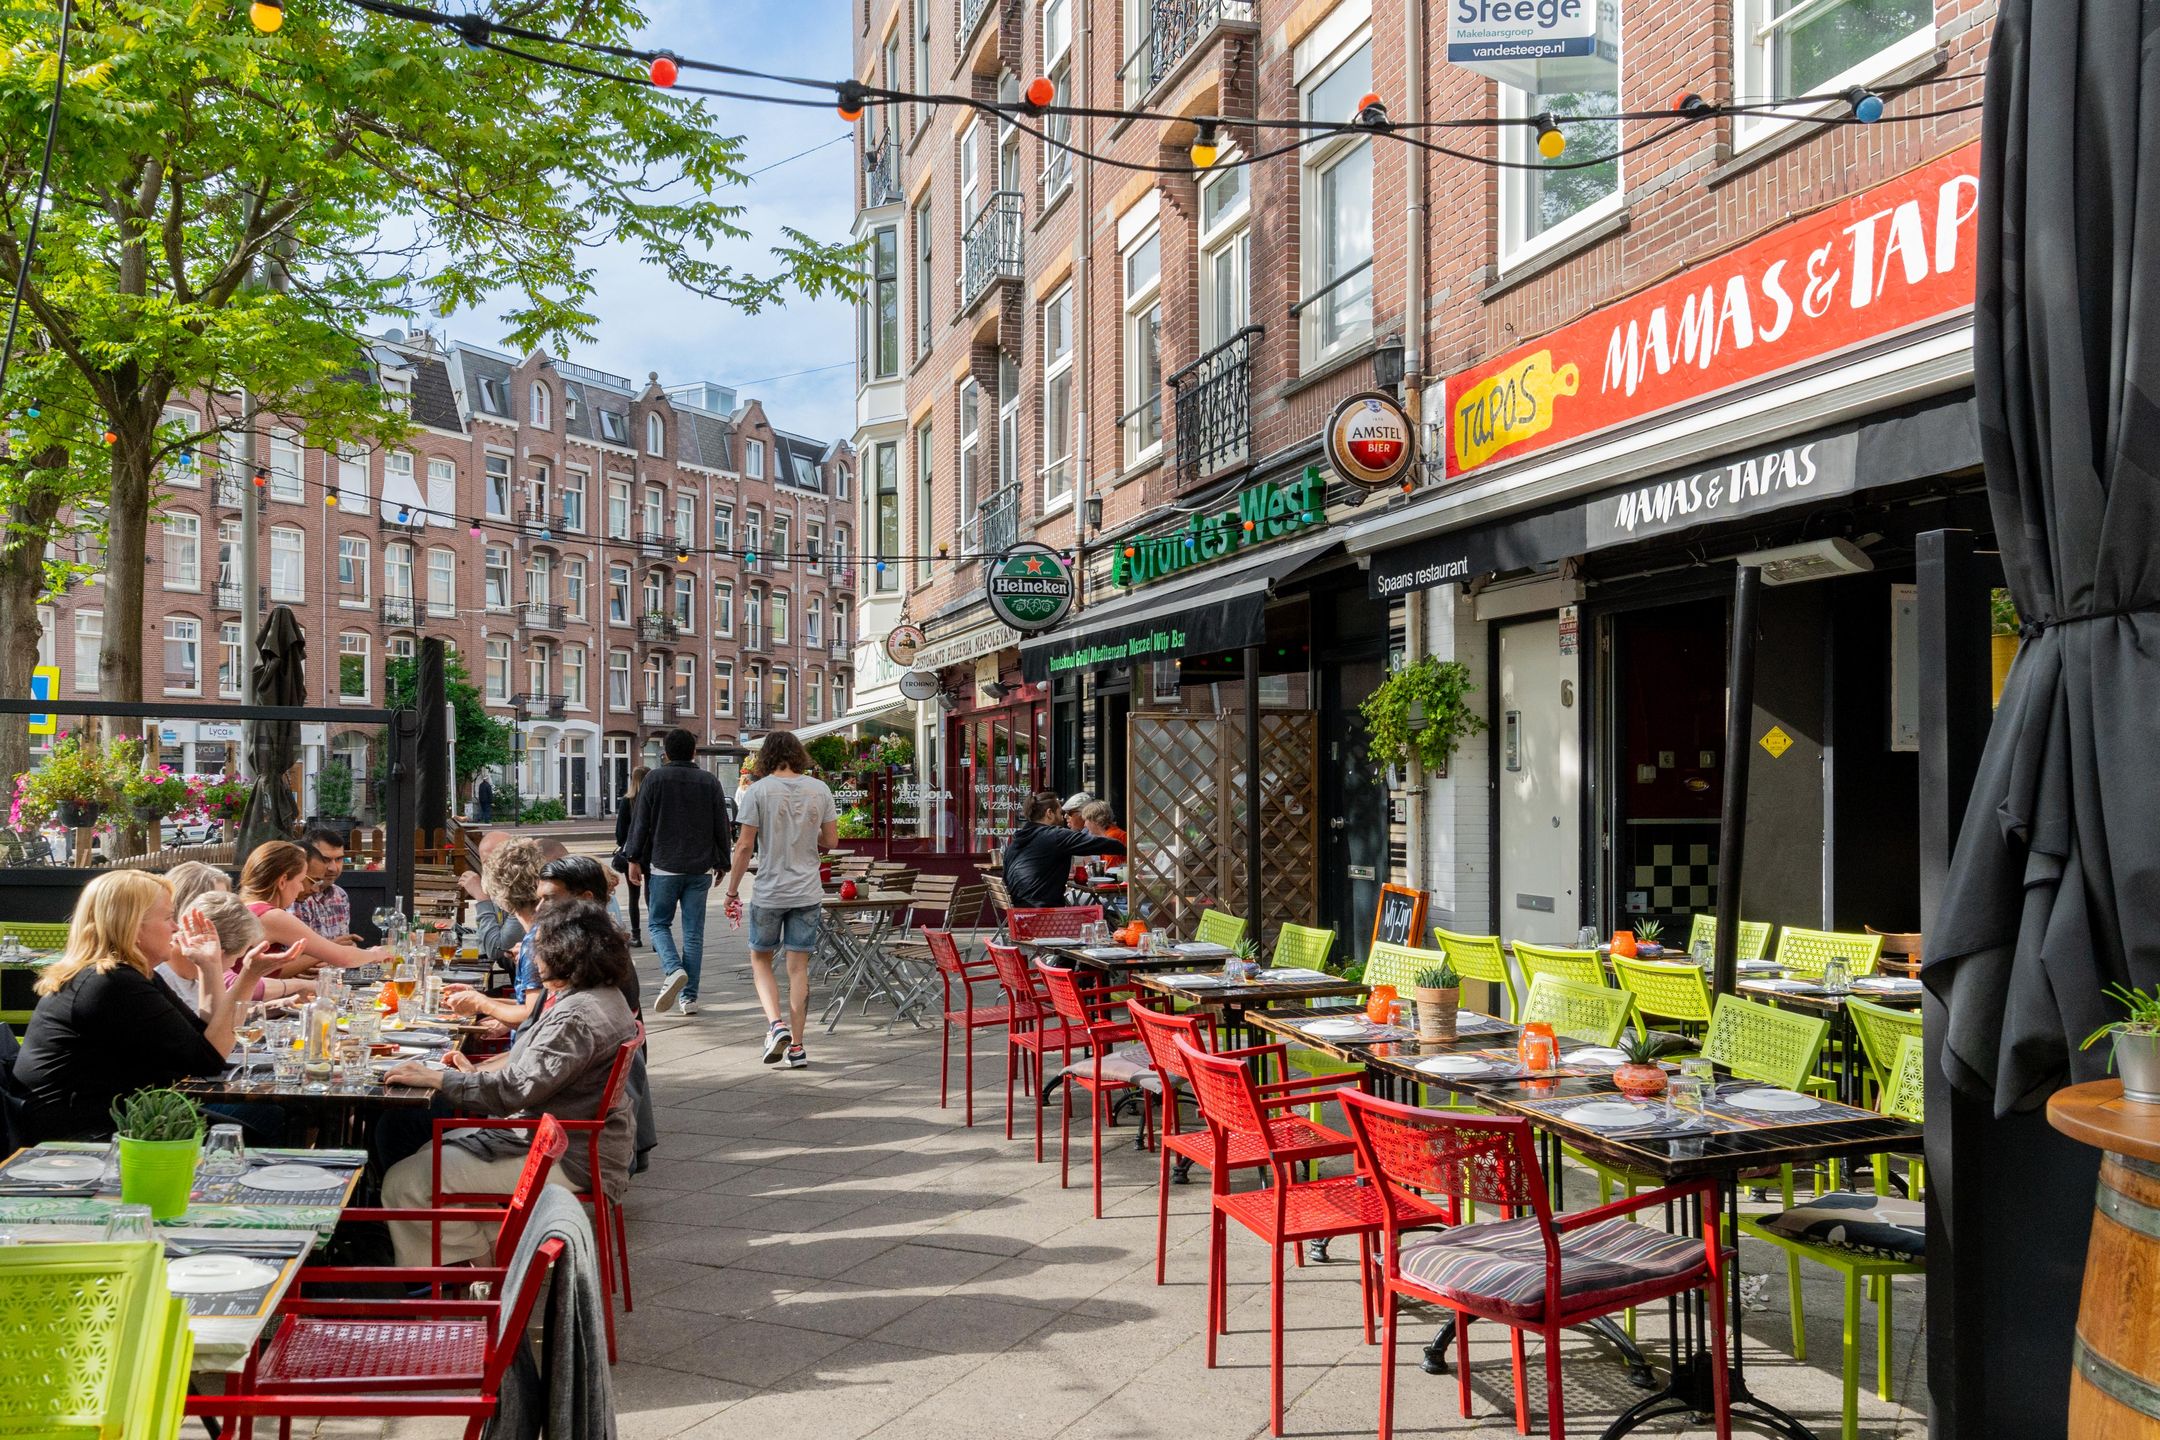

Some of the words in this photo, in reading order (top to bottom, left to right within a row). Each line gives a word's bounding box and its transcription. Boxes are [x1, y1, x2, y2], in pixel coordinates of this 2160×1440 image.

[1456, 28, 1534, 39] Makelaarsgroep
[1472, 41, 1565, 57] vandesteege.nl
[1601, 259, 1793, 397] MAMAS
[1802, 241, 1841, 318] &
[1843, 174, 1979, 309] TAP
[1352, 426, 1402, 440] AMSTEL
[1367, 443, 1391, 453] BIER
[1614, 474, 1703, 532] MAMAS
[1705, 475, 1723, 509] &
[1726, 443, 1816, 503] TAPAS
[1238, 466, 1326, 545] West
[1378, 572, 1413, 596] Spaans
[1415, 555, 1469, 585] restaurant
[996, 579, 1067, 594] Heineken
[1171, 629, 1186, 648] Bar
[947, 640, 972, 661] PIZZERIA
[1392, 653, 1400, 672] 8
[1560, 679, 1574, 708] 6
[209, 727, 228, 737] Lyca
[974, 784, 1032, 794] RISTORANTE
[982, 801, 1023, 811] PIZZERIA
